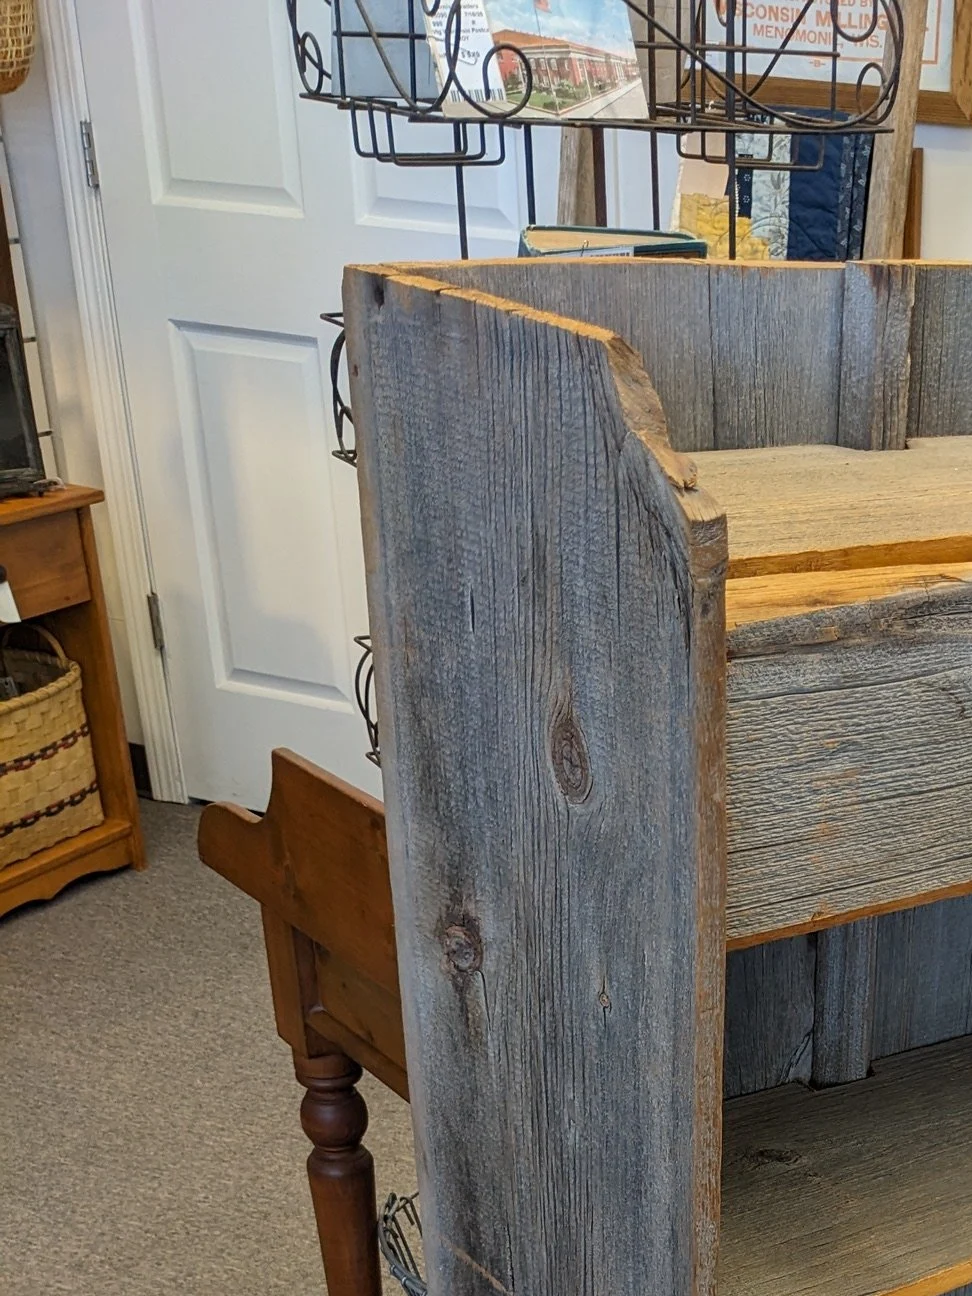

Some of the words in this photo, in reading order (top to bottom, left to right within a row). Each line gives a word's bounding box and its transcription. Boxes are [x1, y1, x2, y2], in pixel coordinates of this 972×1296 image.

[713, 0, 807, 25] SCONSIN
[815, 10, 890, 31] MLLING
[752, 24, 844, 48] MENMONI,
[851, 33, 883, 48] IS.
